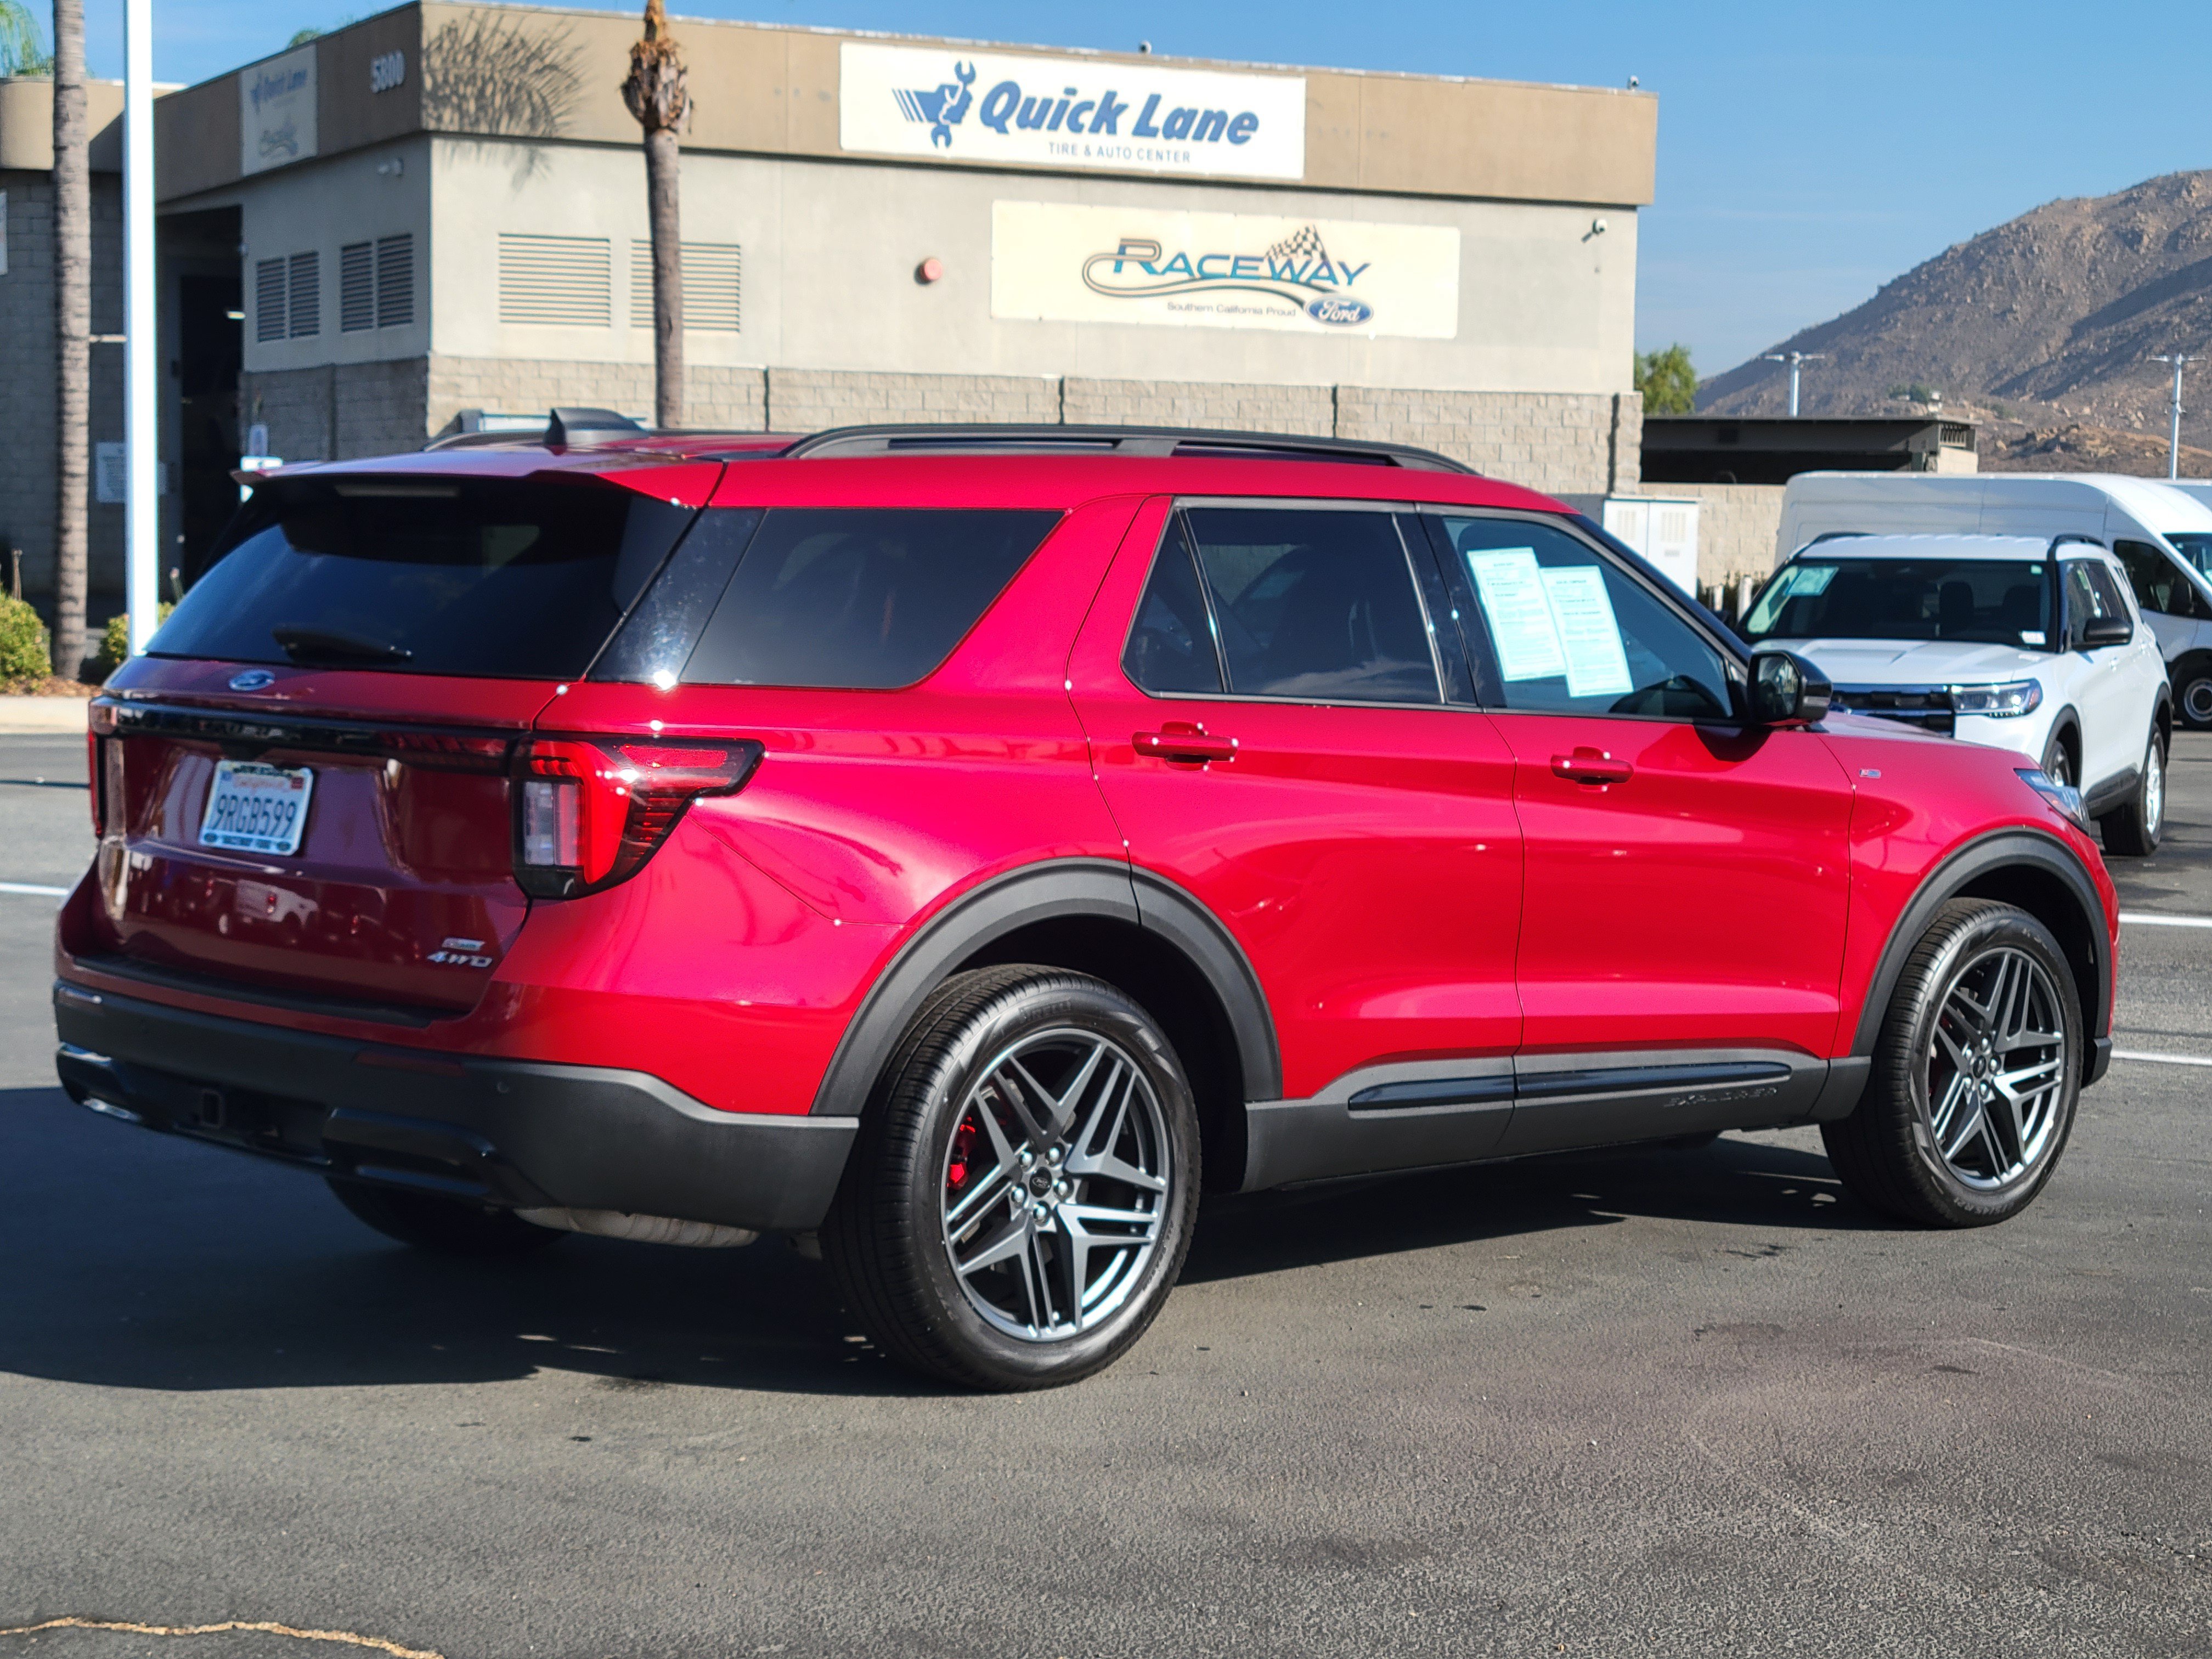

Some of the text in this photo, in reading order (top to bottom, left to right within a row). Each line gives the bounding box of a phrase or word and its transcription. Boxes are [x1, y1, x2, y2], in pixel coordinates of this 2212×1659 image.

[979, 80, 1259, 145] Quick Lane
[1048, 142, 1190, 163] TIRE & AUTO CENTER
[1113, 238, 1372, 286] RACEWAY
[1167, 301, 1296, 317] Southern California Proud
[1318, 298, 1362, 322] Ford
